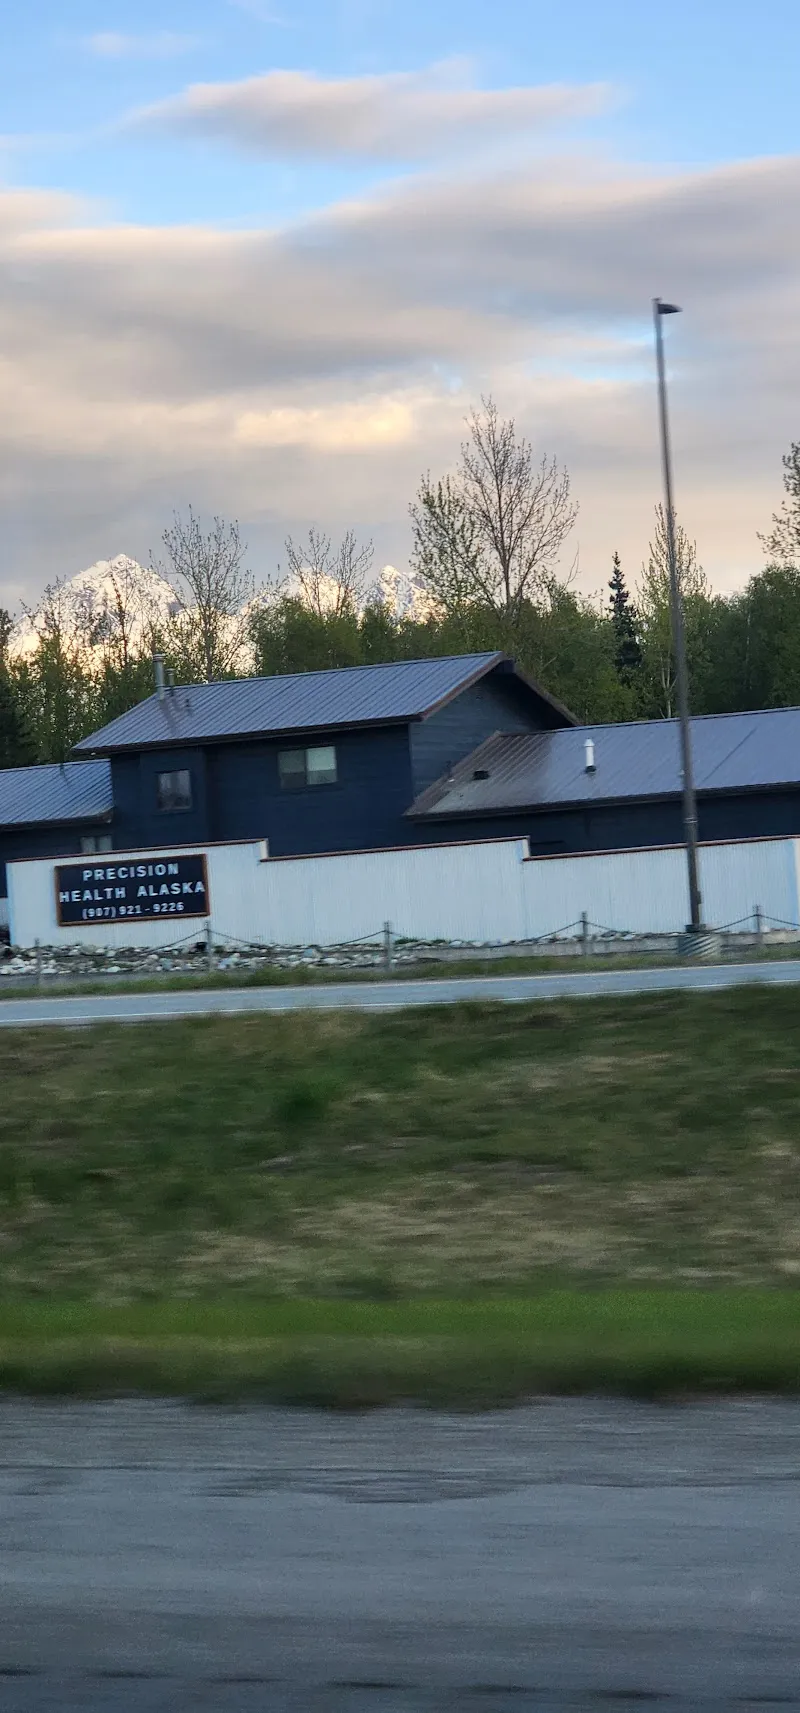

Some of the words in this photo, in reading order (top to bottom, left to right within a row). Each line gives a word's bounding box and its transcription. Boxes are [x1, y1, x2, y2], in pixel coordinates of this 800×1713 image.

[82, 863, 179, 881] PRECISION
[59, 887, 126, 903] HEALTH
[137, 881, 206, 897] ALASKA
[82, 906, 117, 920] (907)
